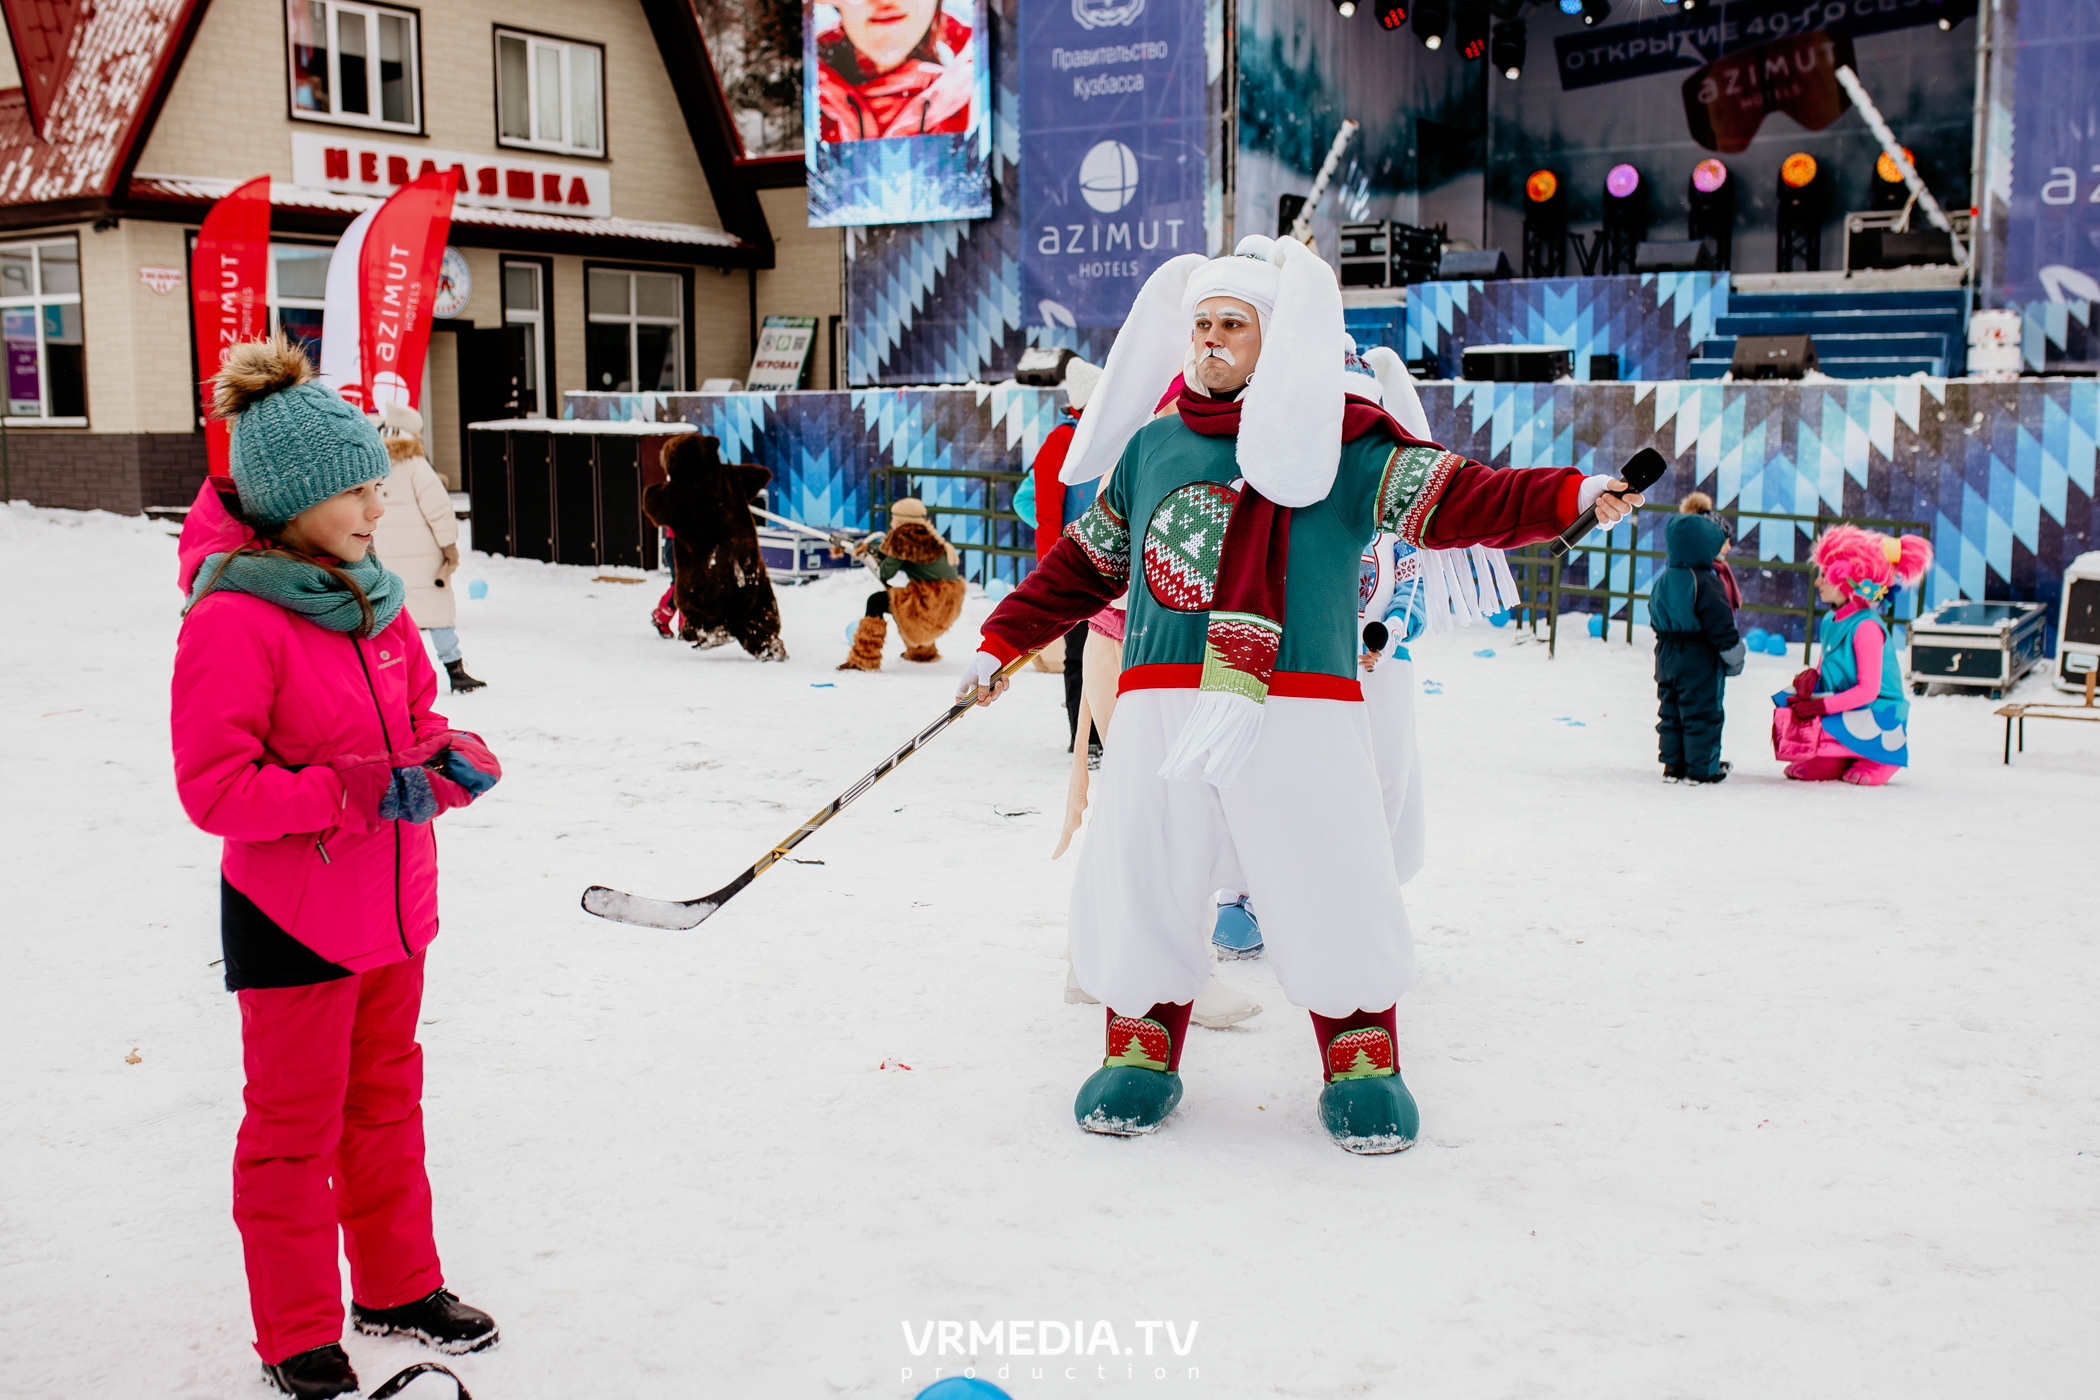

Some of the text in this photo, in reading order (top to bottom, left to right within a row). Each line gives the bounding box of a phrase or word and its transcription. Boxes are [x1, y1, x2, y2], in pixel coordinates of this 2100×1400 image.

[1052, 40, 1168, 72] Правительство
[1073, 72, 1144, 101] Кузбасса
[1079, 260, 1139, 278] HOTELS
[404, 281, 421, 332] HOTELS
